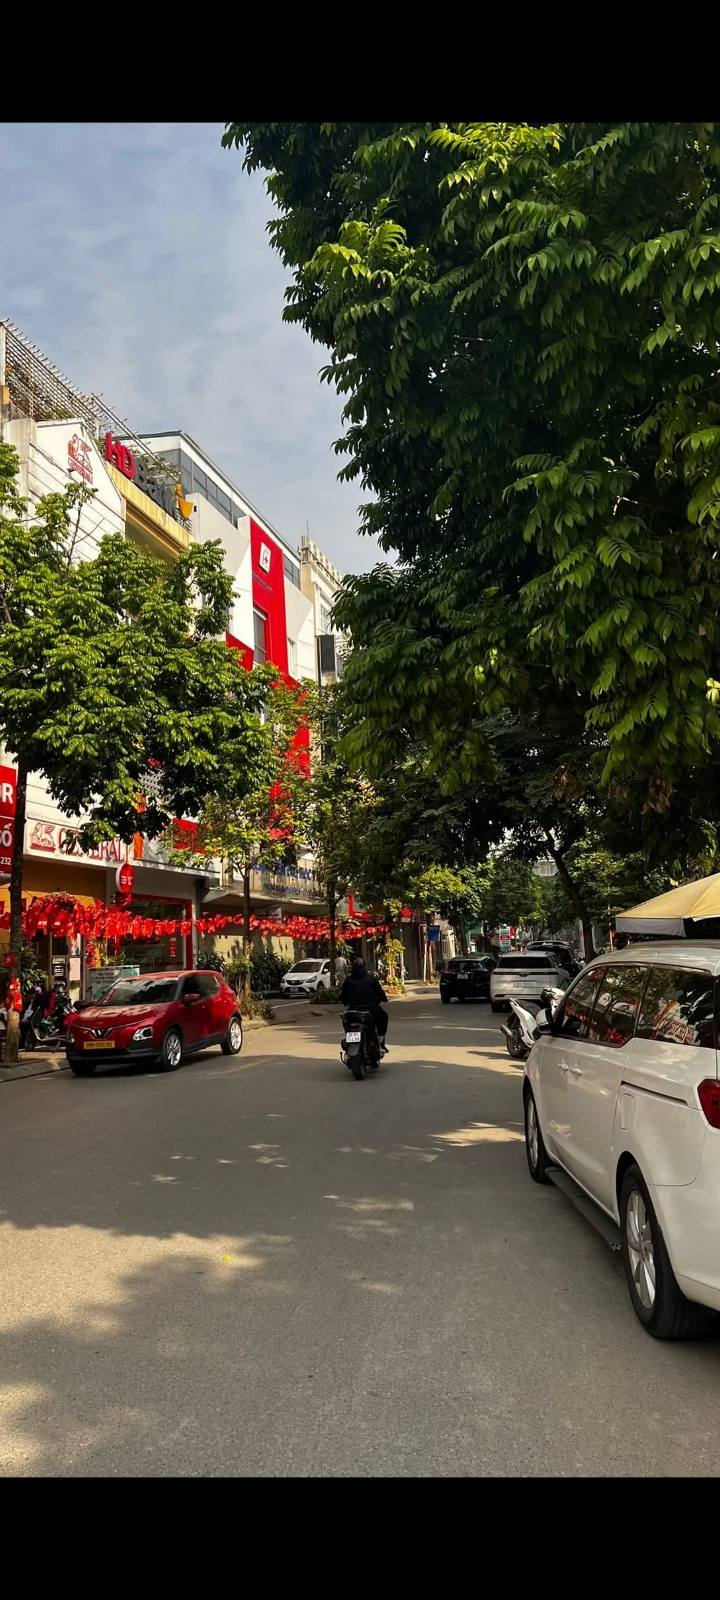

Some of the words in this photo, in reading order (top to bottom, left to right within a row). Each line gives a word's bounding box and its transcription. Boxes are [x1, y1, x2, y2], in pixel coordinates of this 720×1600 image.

[0, 783, 14, 805] R
[0, 823, 13, 848] Ố
[58, 827, 129, 862] GRALI
